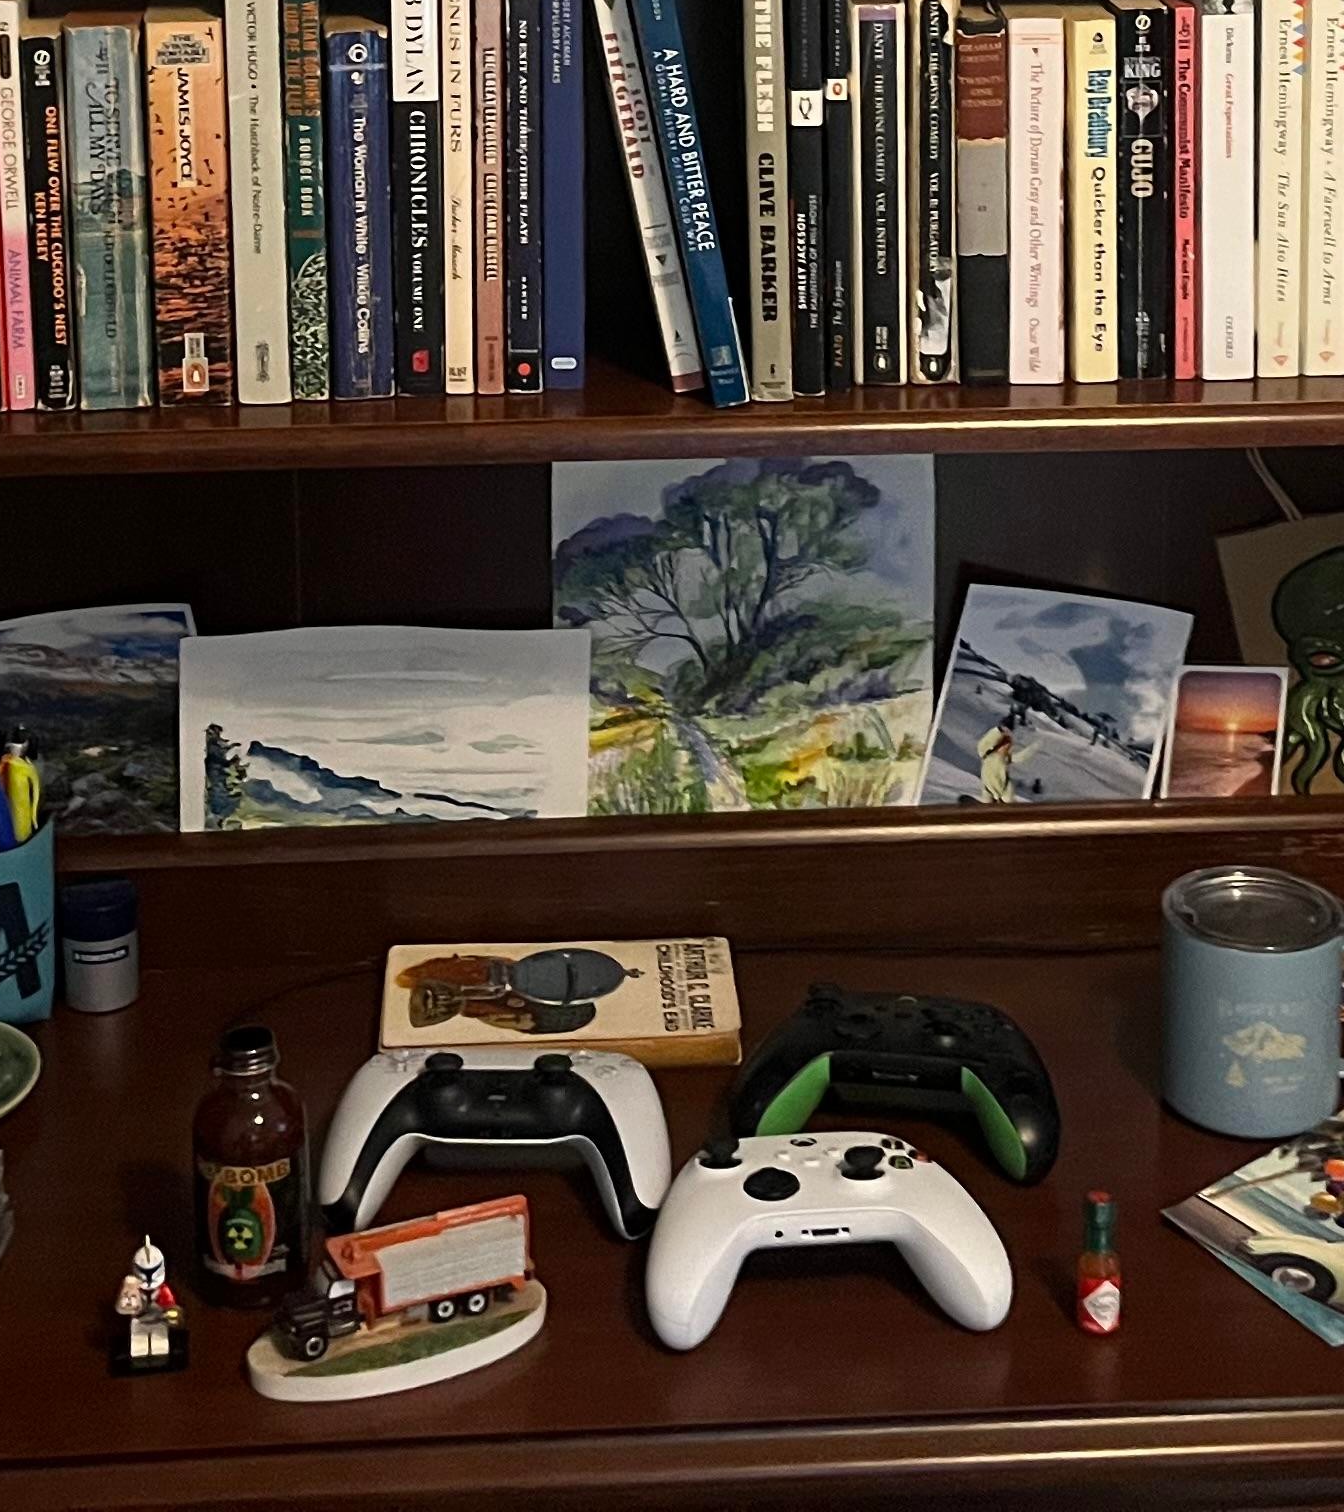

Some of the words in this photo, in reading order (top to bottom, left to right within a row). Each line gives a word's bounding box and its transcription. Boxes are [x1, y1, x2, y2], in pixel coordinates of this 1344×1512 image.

[405, 15, 425, 95] DYLAN
[1278, 19, 1291, 66] Ernest
[1326, 17, 1339, 65] Ernest
[176, 67, 191, 125] JAMES
[665, 64, 689, 108] HARD
[755, 56, 774, 132] FLESH
[1274, 71, 1291, 156] Hemingway
[1321, 70, 1338, 156] Hemingway
[0, 87, 16, 148] GEORGE
[449, 93, 464, 154] FURS
[674, 113, 697, 148] AND
[1086, 95, 1112, 158] Bradbury
[1178, 83, 1192, 154] Communist
[179, 129, 193, 178] JOYCE
[409, 110, 427, 248] CHRONICLES
[681, 151, 706, 200] BITTER
[1131, 139, 1154, 198] CUJO
[758, 152, 776, 217] CLIVE
[1092, 167, 1106, 236] Quicker
[1179, 157, 1192, 219] Manifesto
[692, 202, 716, 251] PEACE
[797, 213, 806, 264] JACKSON
[876, 227, 887, 275] INFERNO
[8, 248, 23, 304] ANIMAL
[51, 243, 66, 310] CUCKOO'S
[759, 225, 778, 322] BARKER
[797, 266, 807, 310] SHIRLEY
[1094, 242, 1106, 282] than
[1094, 289, 1106, 316] the
[224, 1161, 289, 1183] BOMB
